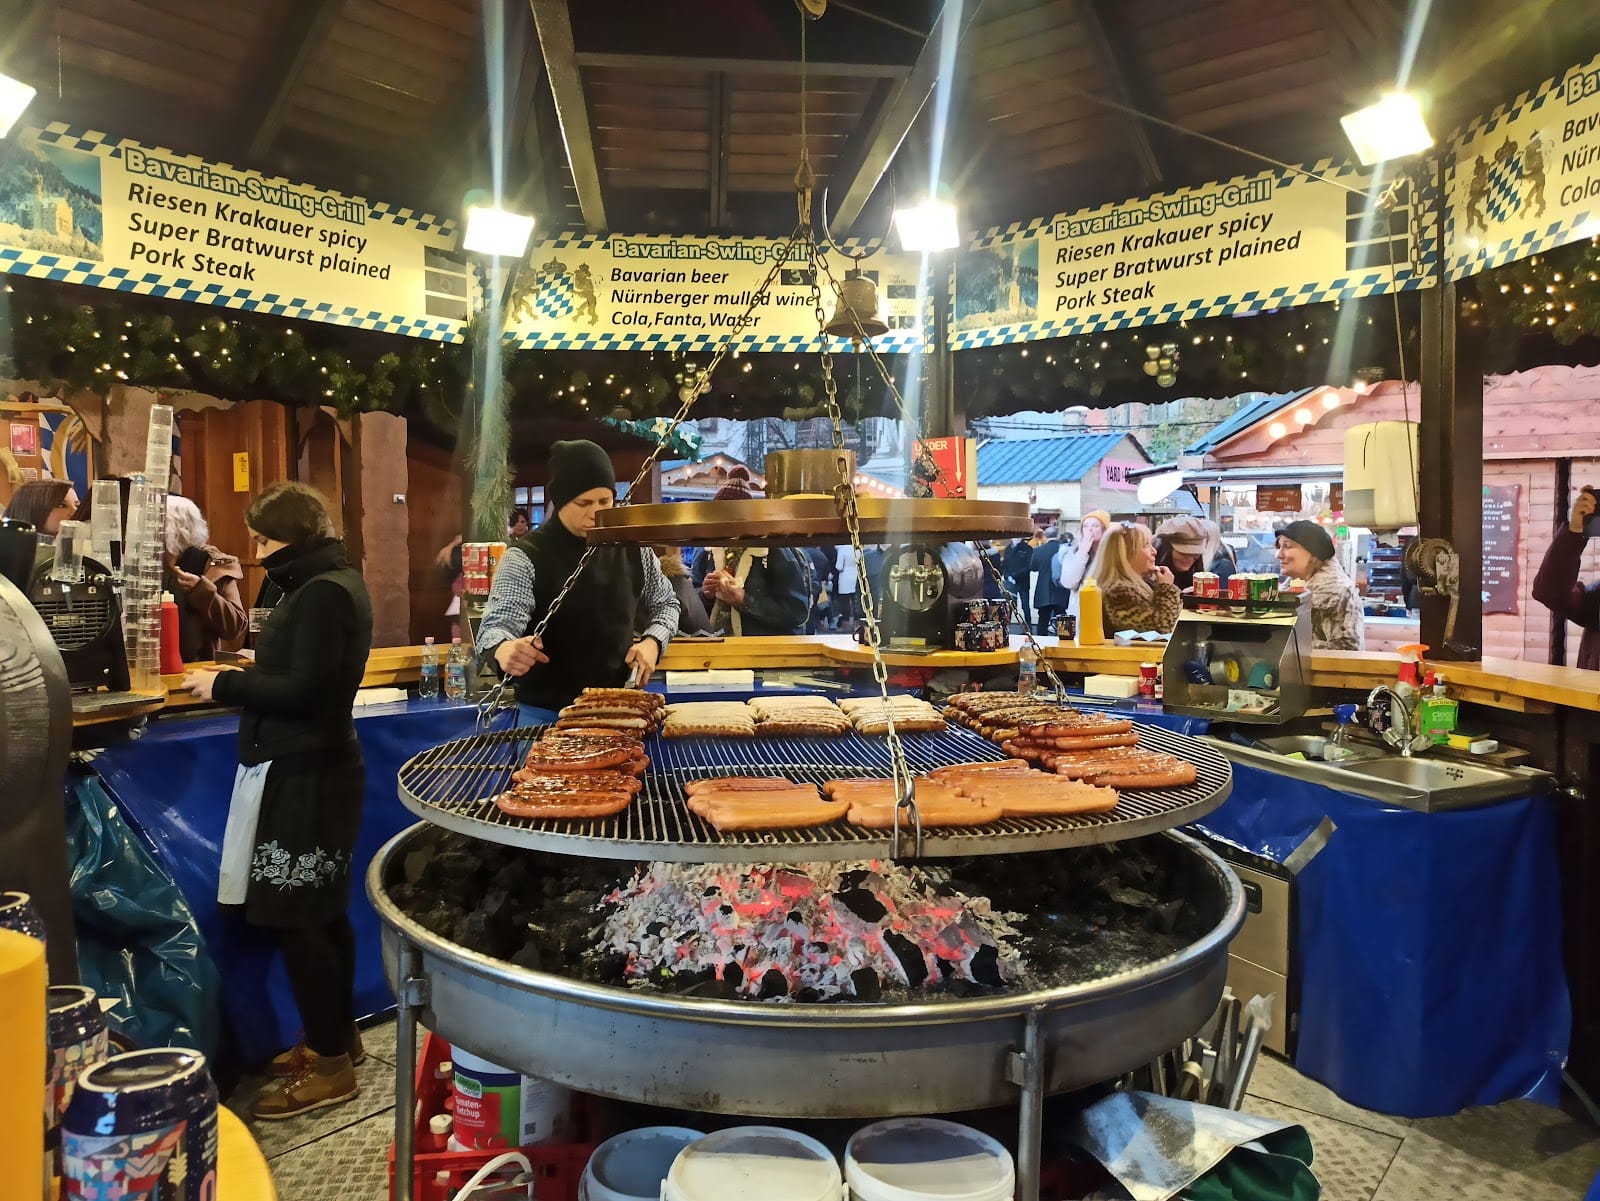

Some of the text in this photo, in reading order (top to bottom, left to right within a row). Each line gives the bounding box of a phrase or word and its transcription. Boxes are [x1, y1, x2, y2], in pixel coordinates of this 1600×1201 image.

[1566, 69, 1600, 106] Ba
[1562, 112, 1600, 143] Bav
[125, 147, 365, 225] Bavarian-Swing-Grill
[1055, 177, 1271, 241] Bavarian-Swing-Grill
[128, 182, 367, 254] Riesen Krakauer spicy
[1055, 212, 1274, 265] Riesen Krakauer spicy
[128, 212, 391, 280] Super Bratwurst plained
[130, 241, 256, 281] Pork Steak
[1055, 230, 1301, 289] Super Bratwurst plained
[611, 267, 729, 284] Bavarian beer
[611, 289, 710, 308] Nürnberger
[713, 290, 771, 306] mulled
[776, 291, 814, 306] wine
[1055, 280, 1156, 312] Pork Steak
